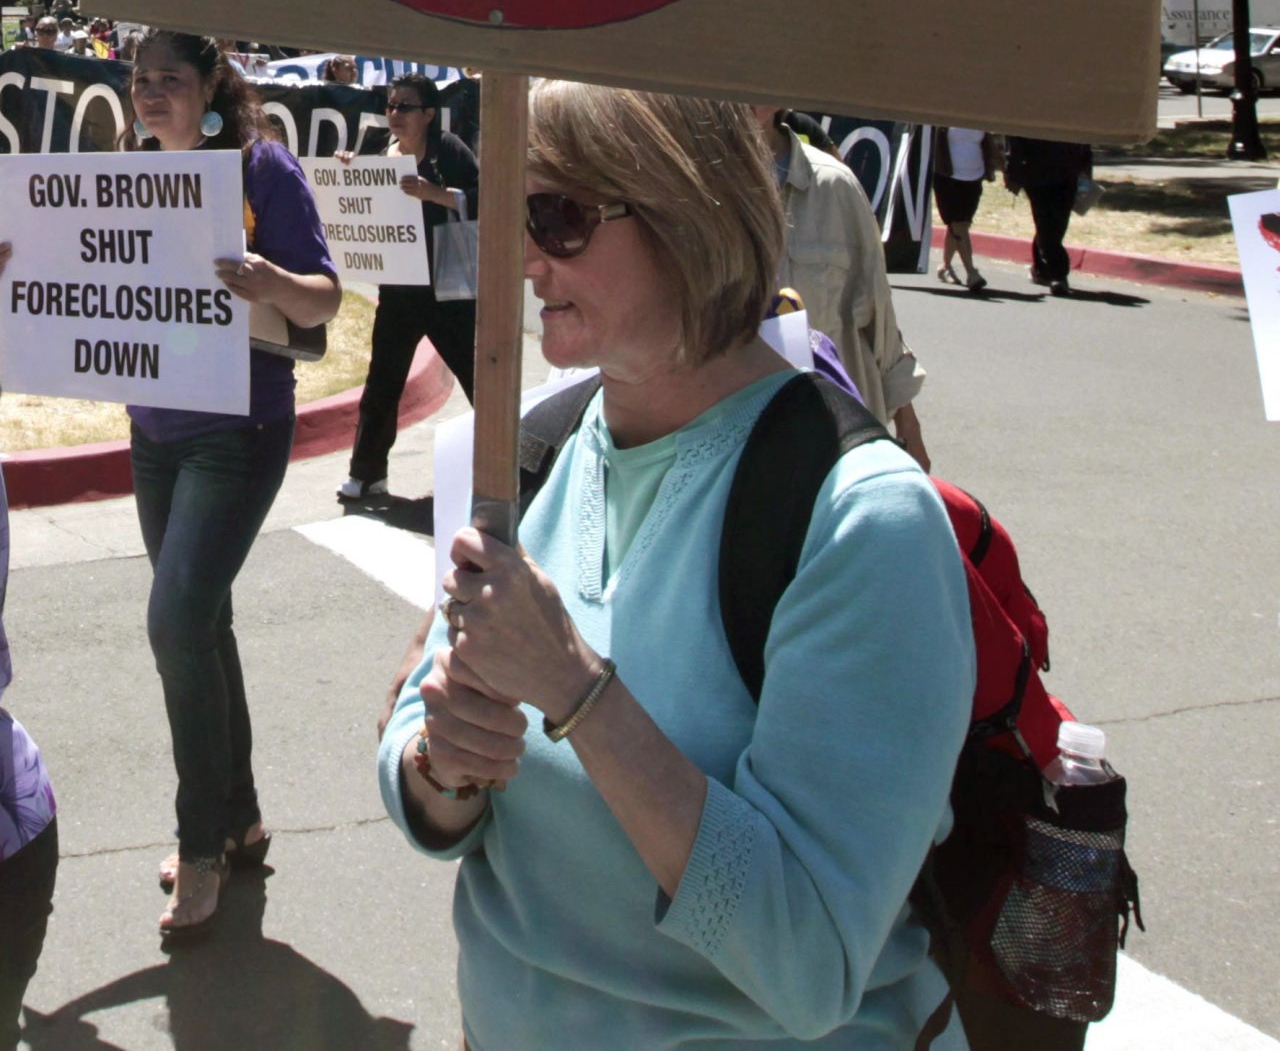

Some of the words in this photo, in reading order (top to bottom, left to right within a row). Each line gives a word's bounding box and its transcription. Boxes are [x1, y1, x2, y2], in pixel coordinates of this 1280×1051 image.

[314, 168, 340, 186] GOV.
[343, 168, 397, 186] BROWN
[29, 174, 88, 208] GOV.
[96, 174, 202, 209] BROWN
[338, 197, 372, 214] SHUT
[80, 228, 153, 264] SHUT
[322, 223, 417, 243] ORECLOSURES
[344, 252, 384, 271] DOWN
[11, 280, 233, 326] FORECLOSURES
[74, 339, 160, 380] DOWN
